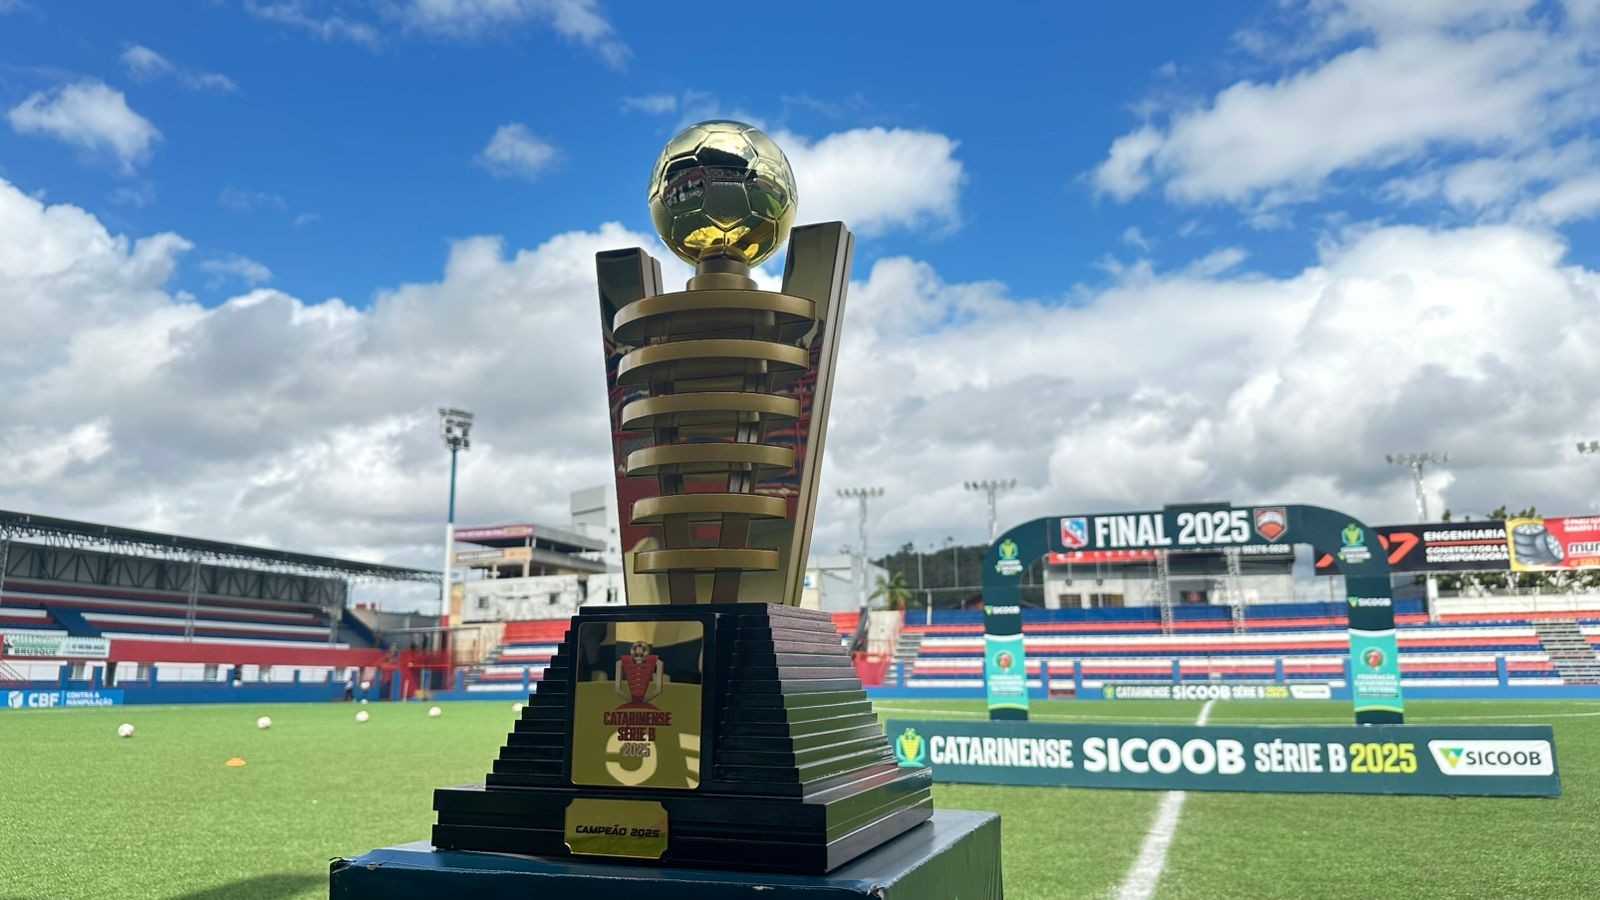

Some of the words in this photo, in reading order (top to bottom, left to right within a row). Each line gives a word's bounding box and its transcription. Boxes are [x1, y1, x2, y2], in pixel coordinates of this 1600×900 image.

[1095, 515, 1172, 548] FINAL
[1177, 509, 1250, 545] 2025
[1423, 528, 1506, 541] ENGENHARIA
[1425, 545, 1499, 555] CONSTRUTORA
[1426, 552, 1509, 562] INCORPORADORA
[14, 647, 57, 656] BRUSQUE
[1115, 686, 1171, 698] CATARINENSE
[1172, 685, 1231, 699] SICOOB
[1232, 685, 1256, 698] SÉRIE
[28, 692, 59, 707] CBF
[66, 697, 113, 706] MANIPULAÇÃO
[603, 711, 672, 726] CATARINENSE
[648, 727, 656, 741] B
[623, 742, 651, 757] 2025
[929, 735, 1074, 768] CATARINENSE
[1082, 737, 1246, 775] SICOOB
[1254, 739, 1323, 773] SÉRIE
[1327, 743, 1347, 773] B
[1350, 743, 1417, 774] 2025
[1466, 751, 1541, 766] SICOOB
[576, 824, 627, 836] CAMPEÃO
[630, 828, 661, 838] 2025
